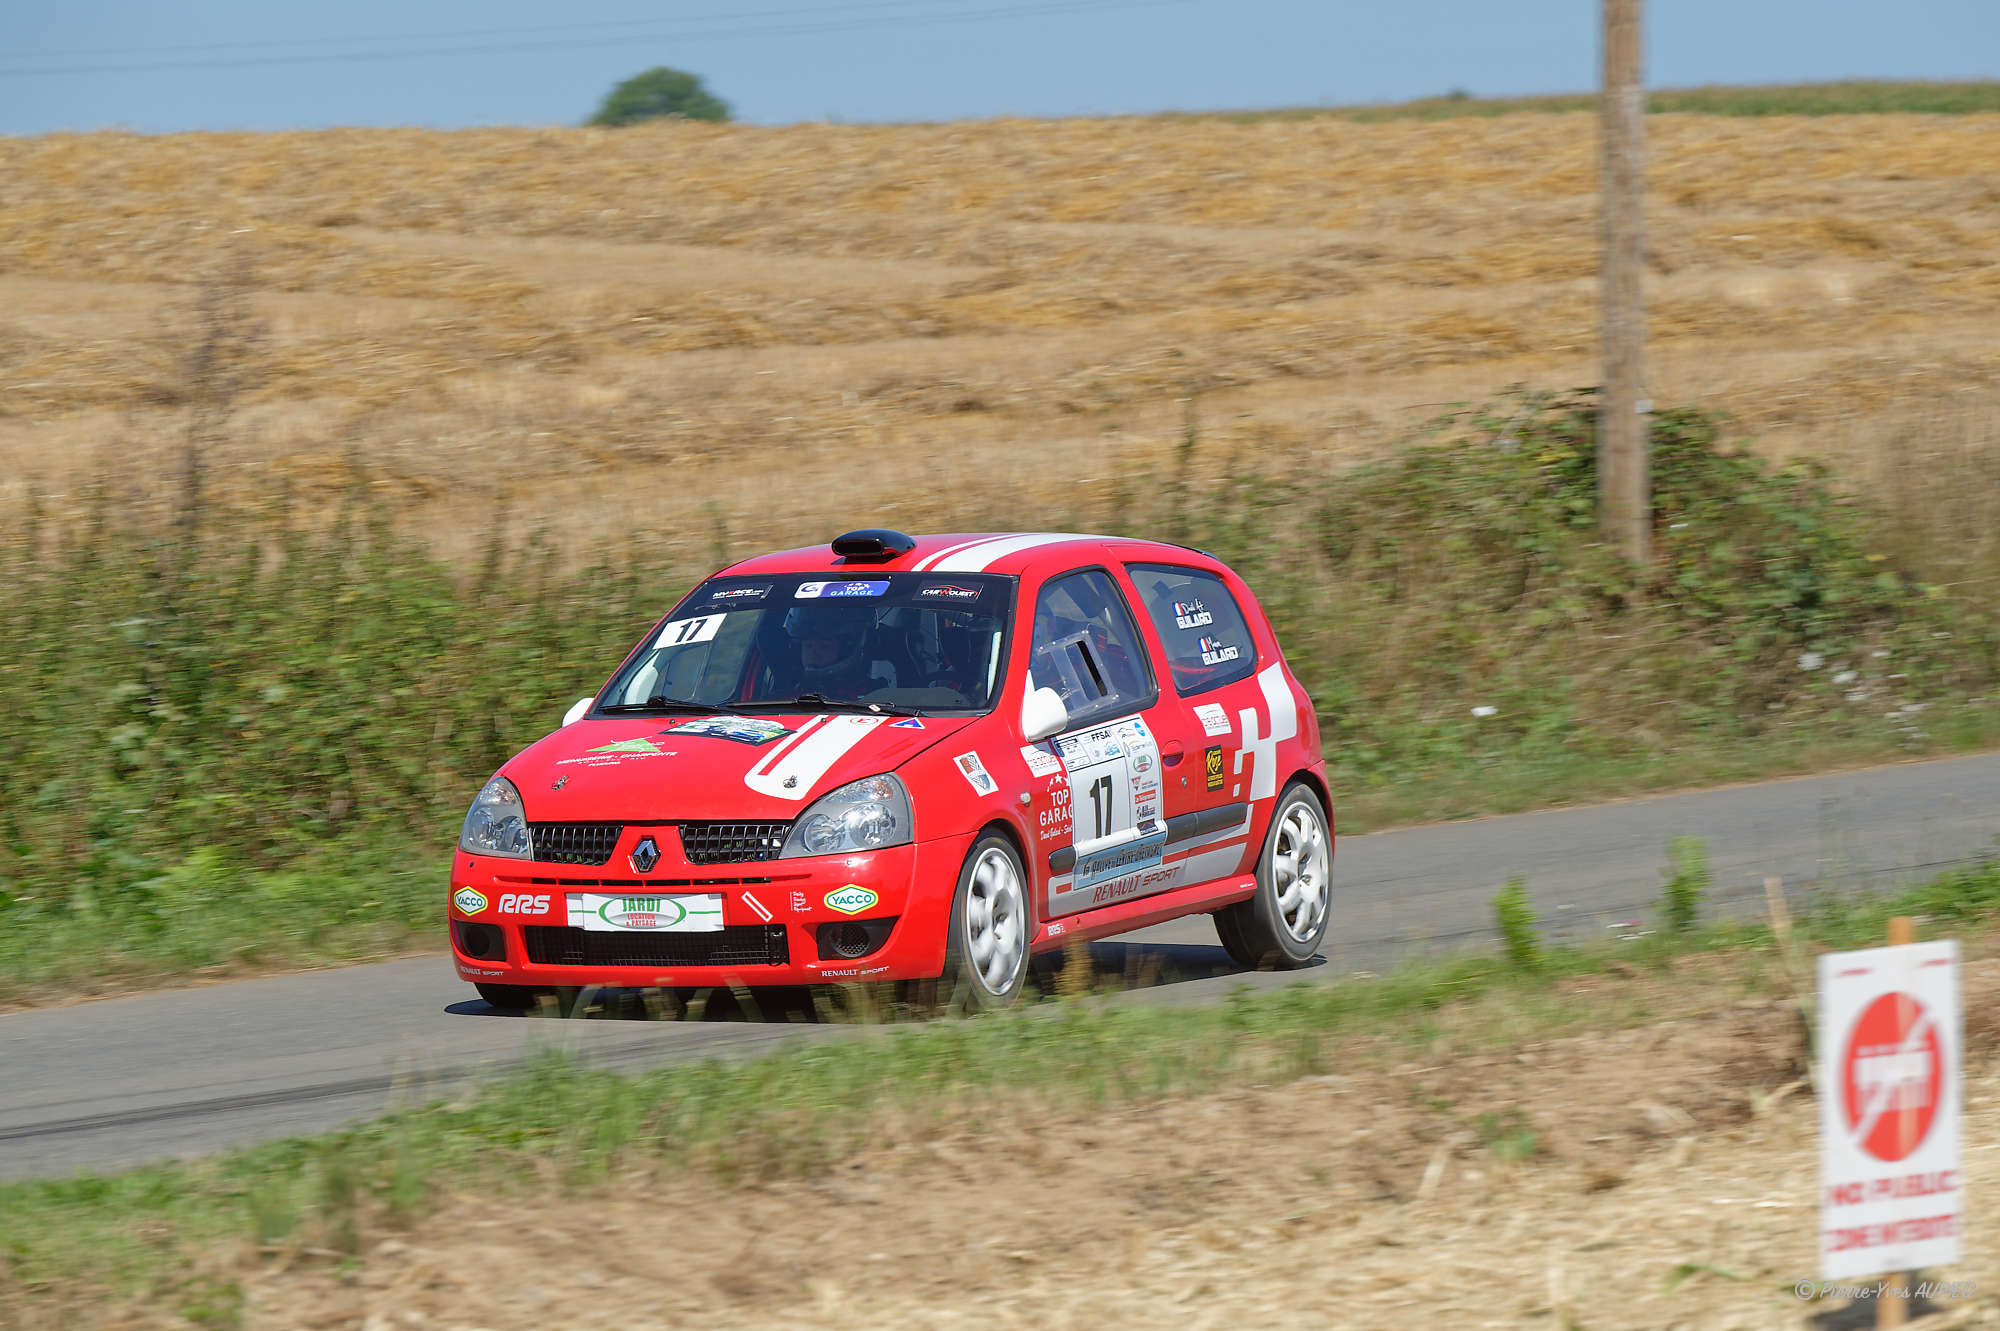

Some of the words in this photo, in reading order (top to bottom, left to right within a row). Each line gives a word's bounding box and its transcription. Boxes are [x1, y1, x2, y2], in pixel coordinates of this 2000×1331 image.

[675, 618, 708, 643] 17
[1091, 730, 1110, 742] FFSA
[1050, 788, 1069, 807] TOP
[1089, 774, 1113, 840] 17
[1040, 804, 1073, 826] GARAG
[1092, 874, 1140, 904] RENAULT
[1141, 866, 1181, 888] SPORT
[457, 896, 483, 907] YACCO
[498, 893, 551, 915] RRS
[622, 897, 661, 912] JARDI
[832, 894, 873, 905] YACCO
[821, 968, 858, 977] RENAULT
[860, 966, 889, 975] SPORT
